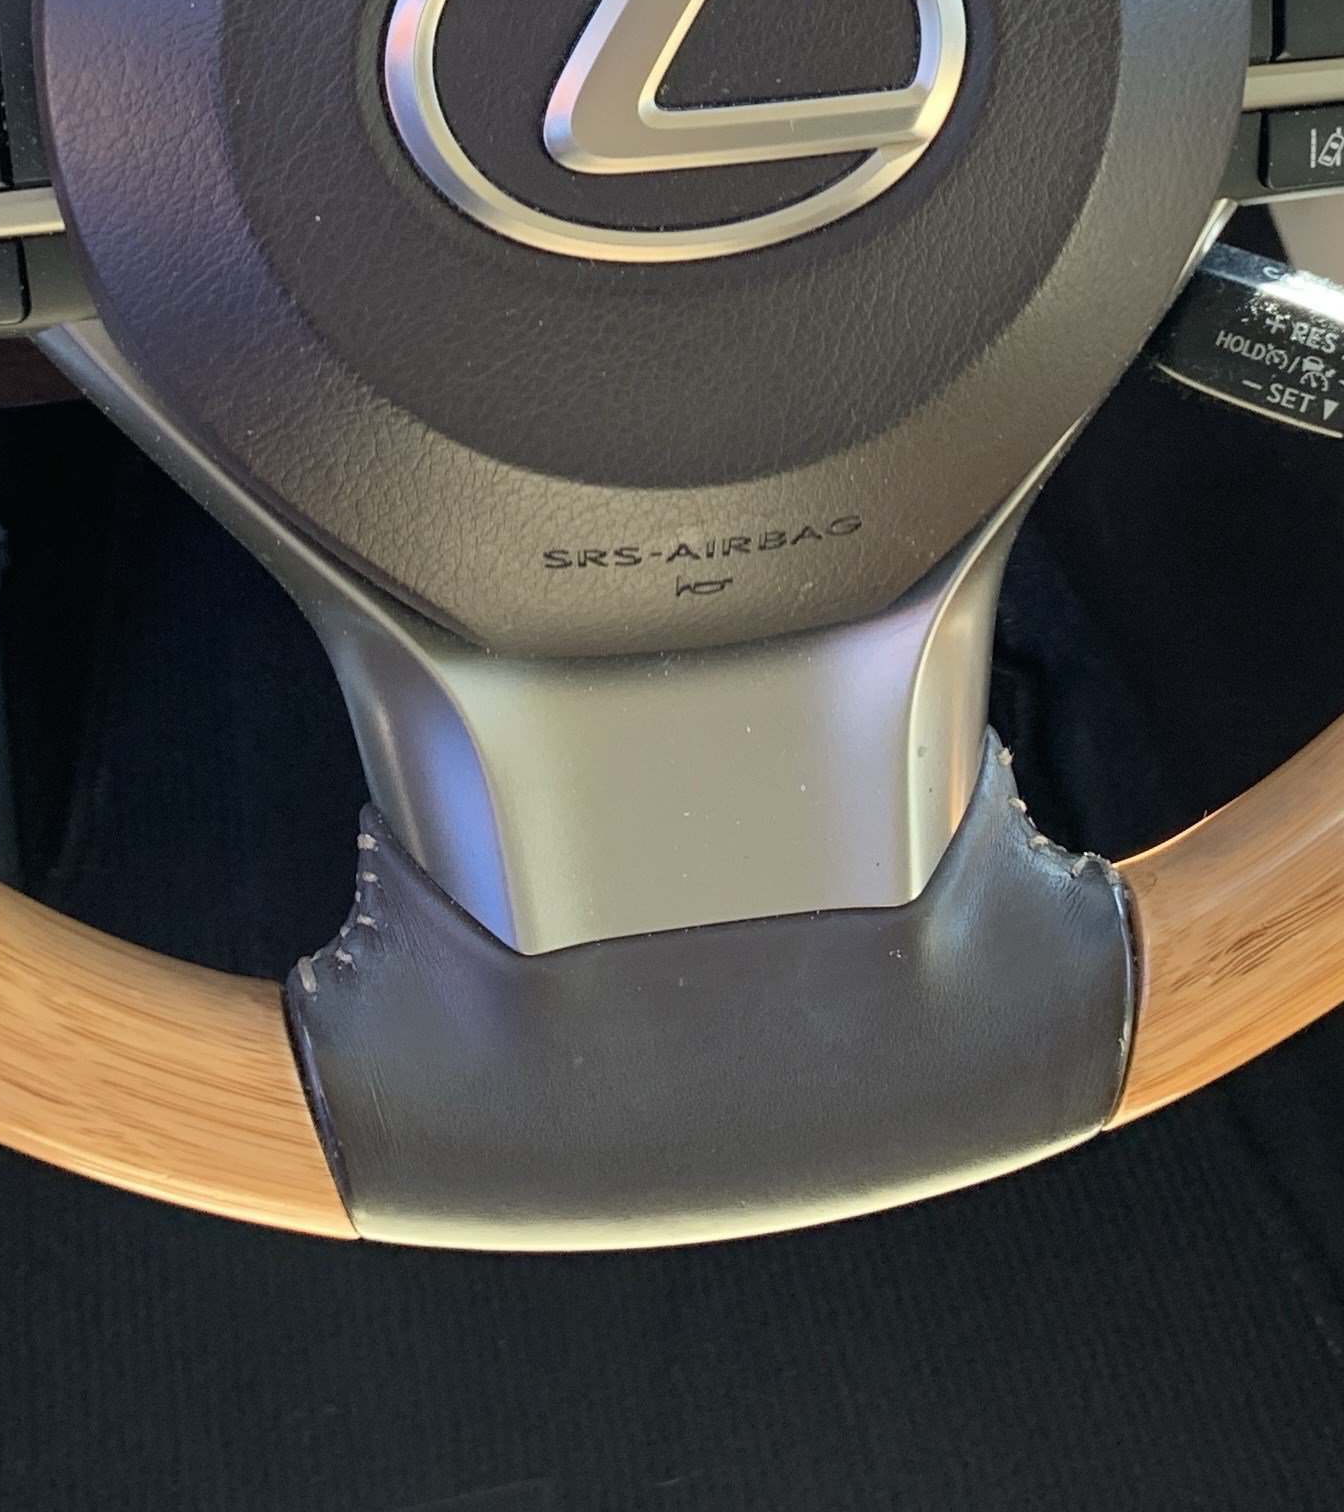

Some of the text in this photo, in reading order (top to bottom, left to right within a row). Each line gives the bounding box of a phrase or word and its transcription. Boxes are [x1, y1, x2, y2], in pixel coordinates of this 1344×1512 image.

[1214, 329, 1265, 360] HOLD
[1266, 383, 1316, 414] SET
[542, 514, 863, 570] SRS-AIRBAG
